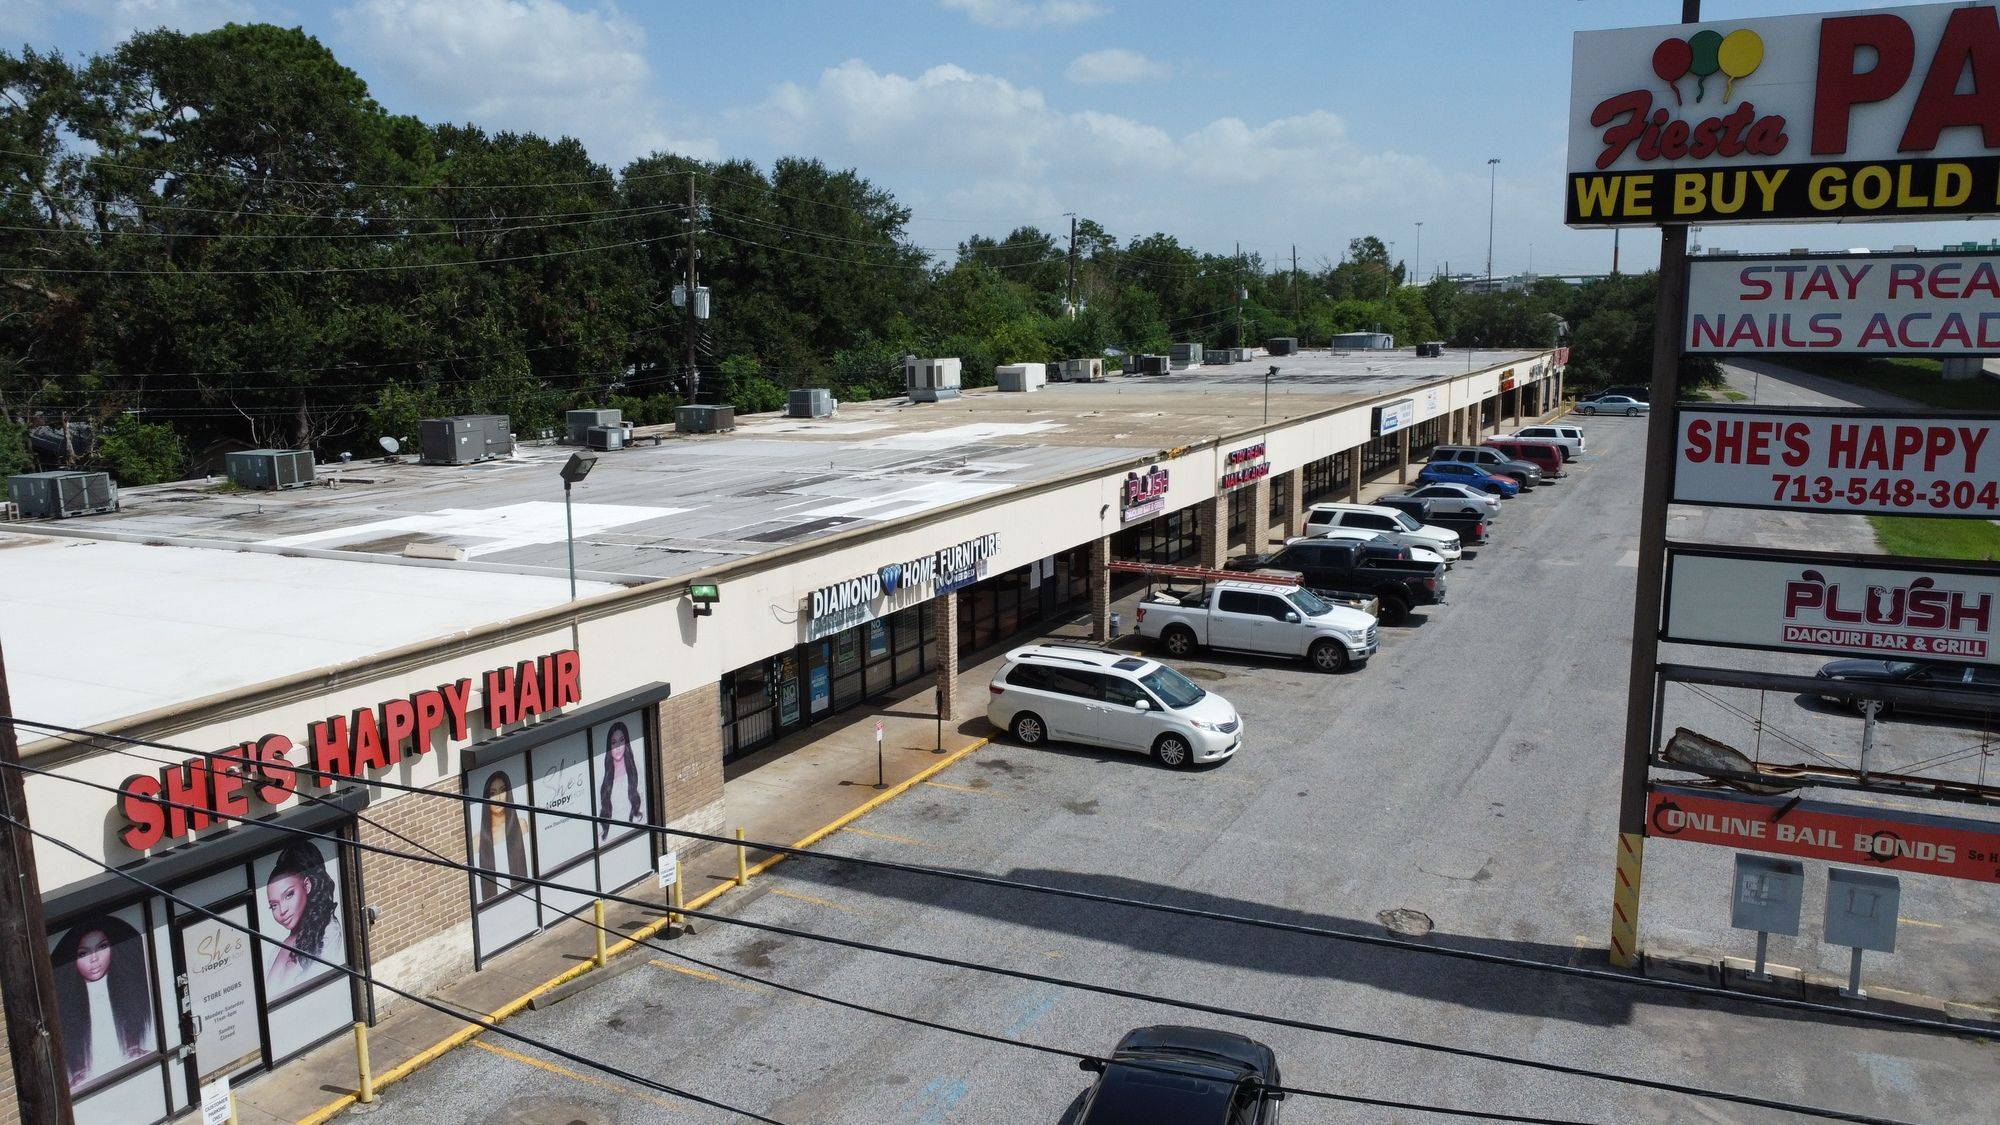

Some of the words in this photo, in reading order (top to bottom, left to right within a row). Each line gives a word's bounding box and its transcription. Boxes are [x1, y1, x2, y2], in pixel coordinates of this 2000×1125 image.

[1590, 89, 1789, 169] Fiesta
[1810, 5, 2000, 155] PA
[1574, 174, 1655, 218] WE
[1673, 168, 1790, 216] BUY
[1808, 163, 1973, 211] GOLD
[1739, 264, 1874, 301] STAY
[1888, 262, 2000, 299] REA
[1691, 312, 1843, 348] NAILS
[1684, 418, 1812, 468] SHE'S
[1827, 424, 1990, 474] HAPPY
[1125, 468, 1169, 507] PLUSH
[1771, 474, 2000, 510] 713-548-304
[809, 572, 881, 619] DIAMOND
[901, 554, 937, 589] HOME
[938, 531, 1002, 575] FURNITURE
[1783, 576, 1994, 635] PLUSH
[1786, 626, 1867, 647] DAIQUIRI
[1871, 632, 1909, 651] BAR
[1912, 636, 1929, 652] &
[1932, 639, 1984, 656] GRILL
[118, 732, 297, 851] SHE'S
[308, 678, 472, 789] HAPPY
[483, 649, 581, 730] HAIR
[1667, 809, 1767, 839] ONLINE
[1776, 824, 1843, 849] BAIL
[1854, 833, 1957, 864] BONDS
[203, 989, 222, 1003] STORE
[222, 981, 242, 994] HOURS
